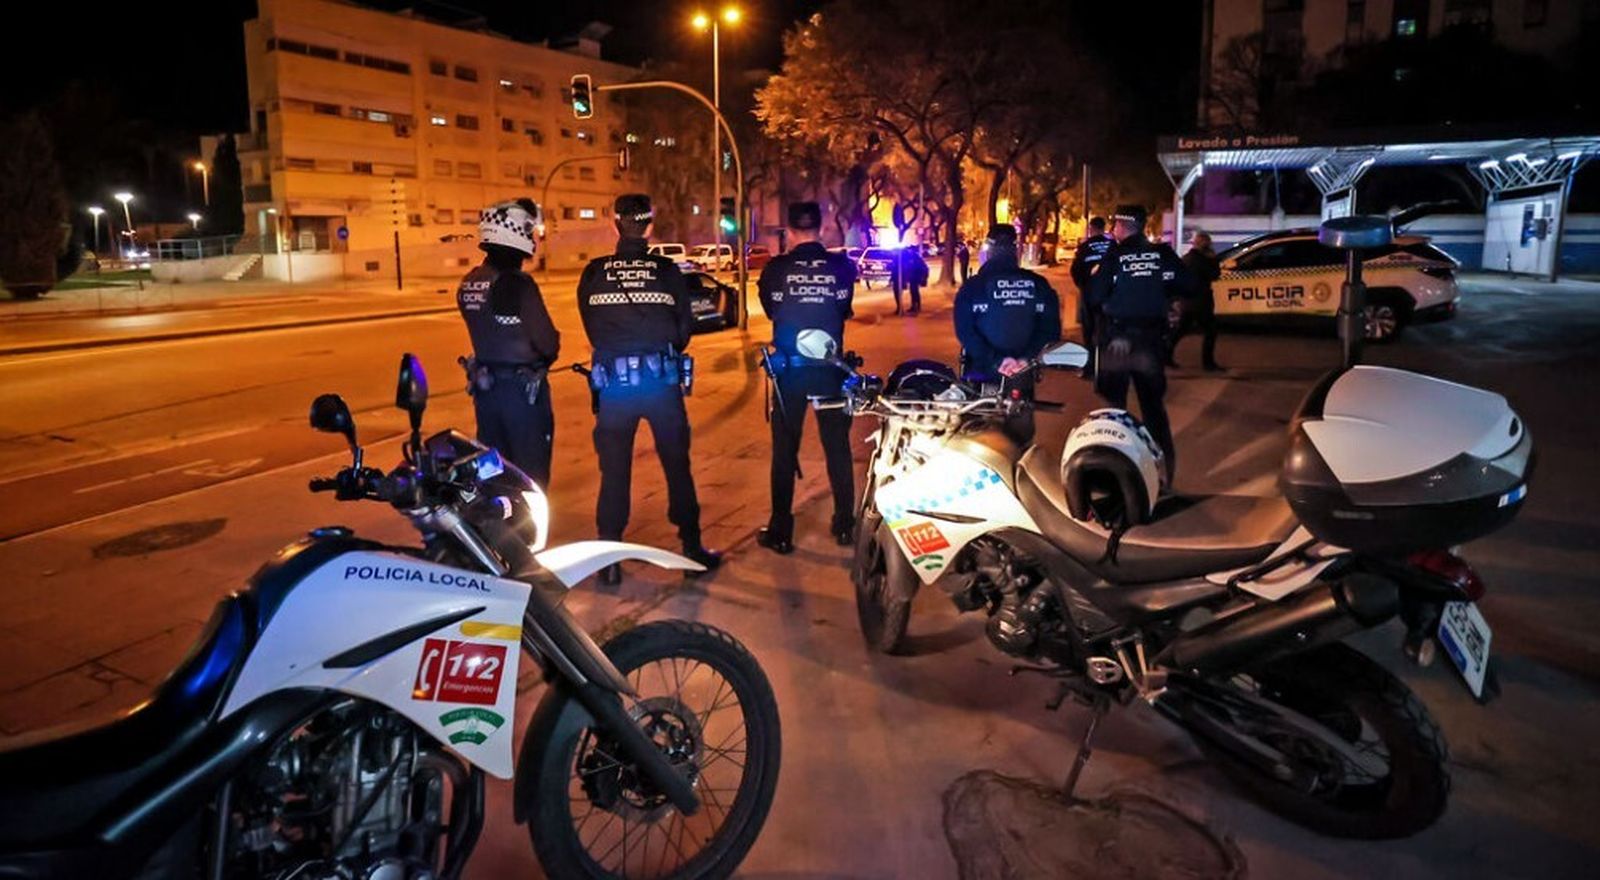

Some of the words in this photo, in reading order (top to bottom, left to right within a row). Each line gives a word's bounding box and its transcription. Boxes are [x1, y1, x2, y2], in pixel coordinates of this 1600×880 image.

[1178, 137, 1228, 149] Lavado
[1120, 252, 1160, 262] POLICIA
[604, 260, 657, 269] POLICIA
[1122, 262, 1160, 271] LOCAL
[606, 270, 656, 281] LOCAL
[787, 274, 836, 284] POLICIA
[997, 280, 1035, 288] OLICIA
[790, 286, 834, 296] LOCAL
[993, 290, 1034, 299] LOCAL
[1228, 286, 1304, 301] POLICIA
[462, 293, 486, 302] OCAL
[1266, 300, 1304, 308] LOCAL
[912, 526, 941, 542] 112
[344, 566, 424, 582] POLICIA
[429, 572, 491, 592] LOCAL
[448, 653, 500, 680] 112
